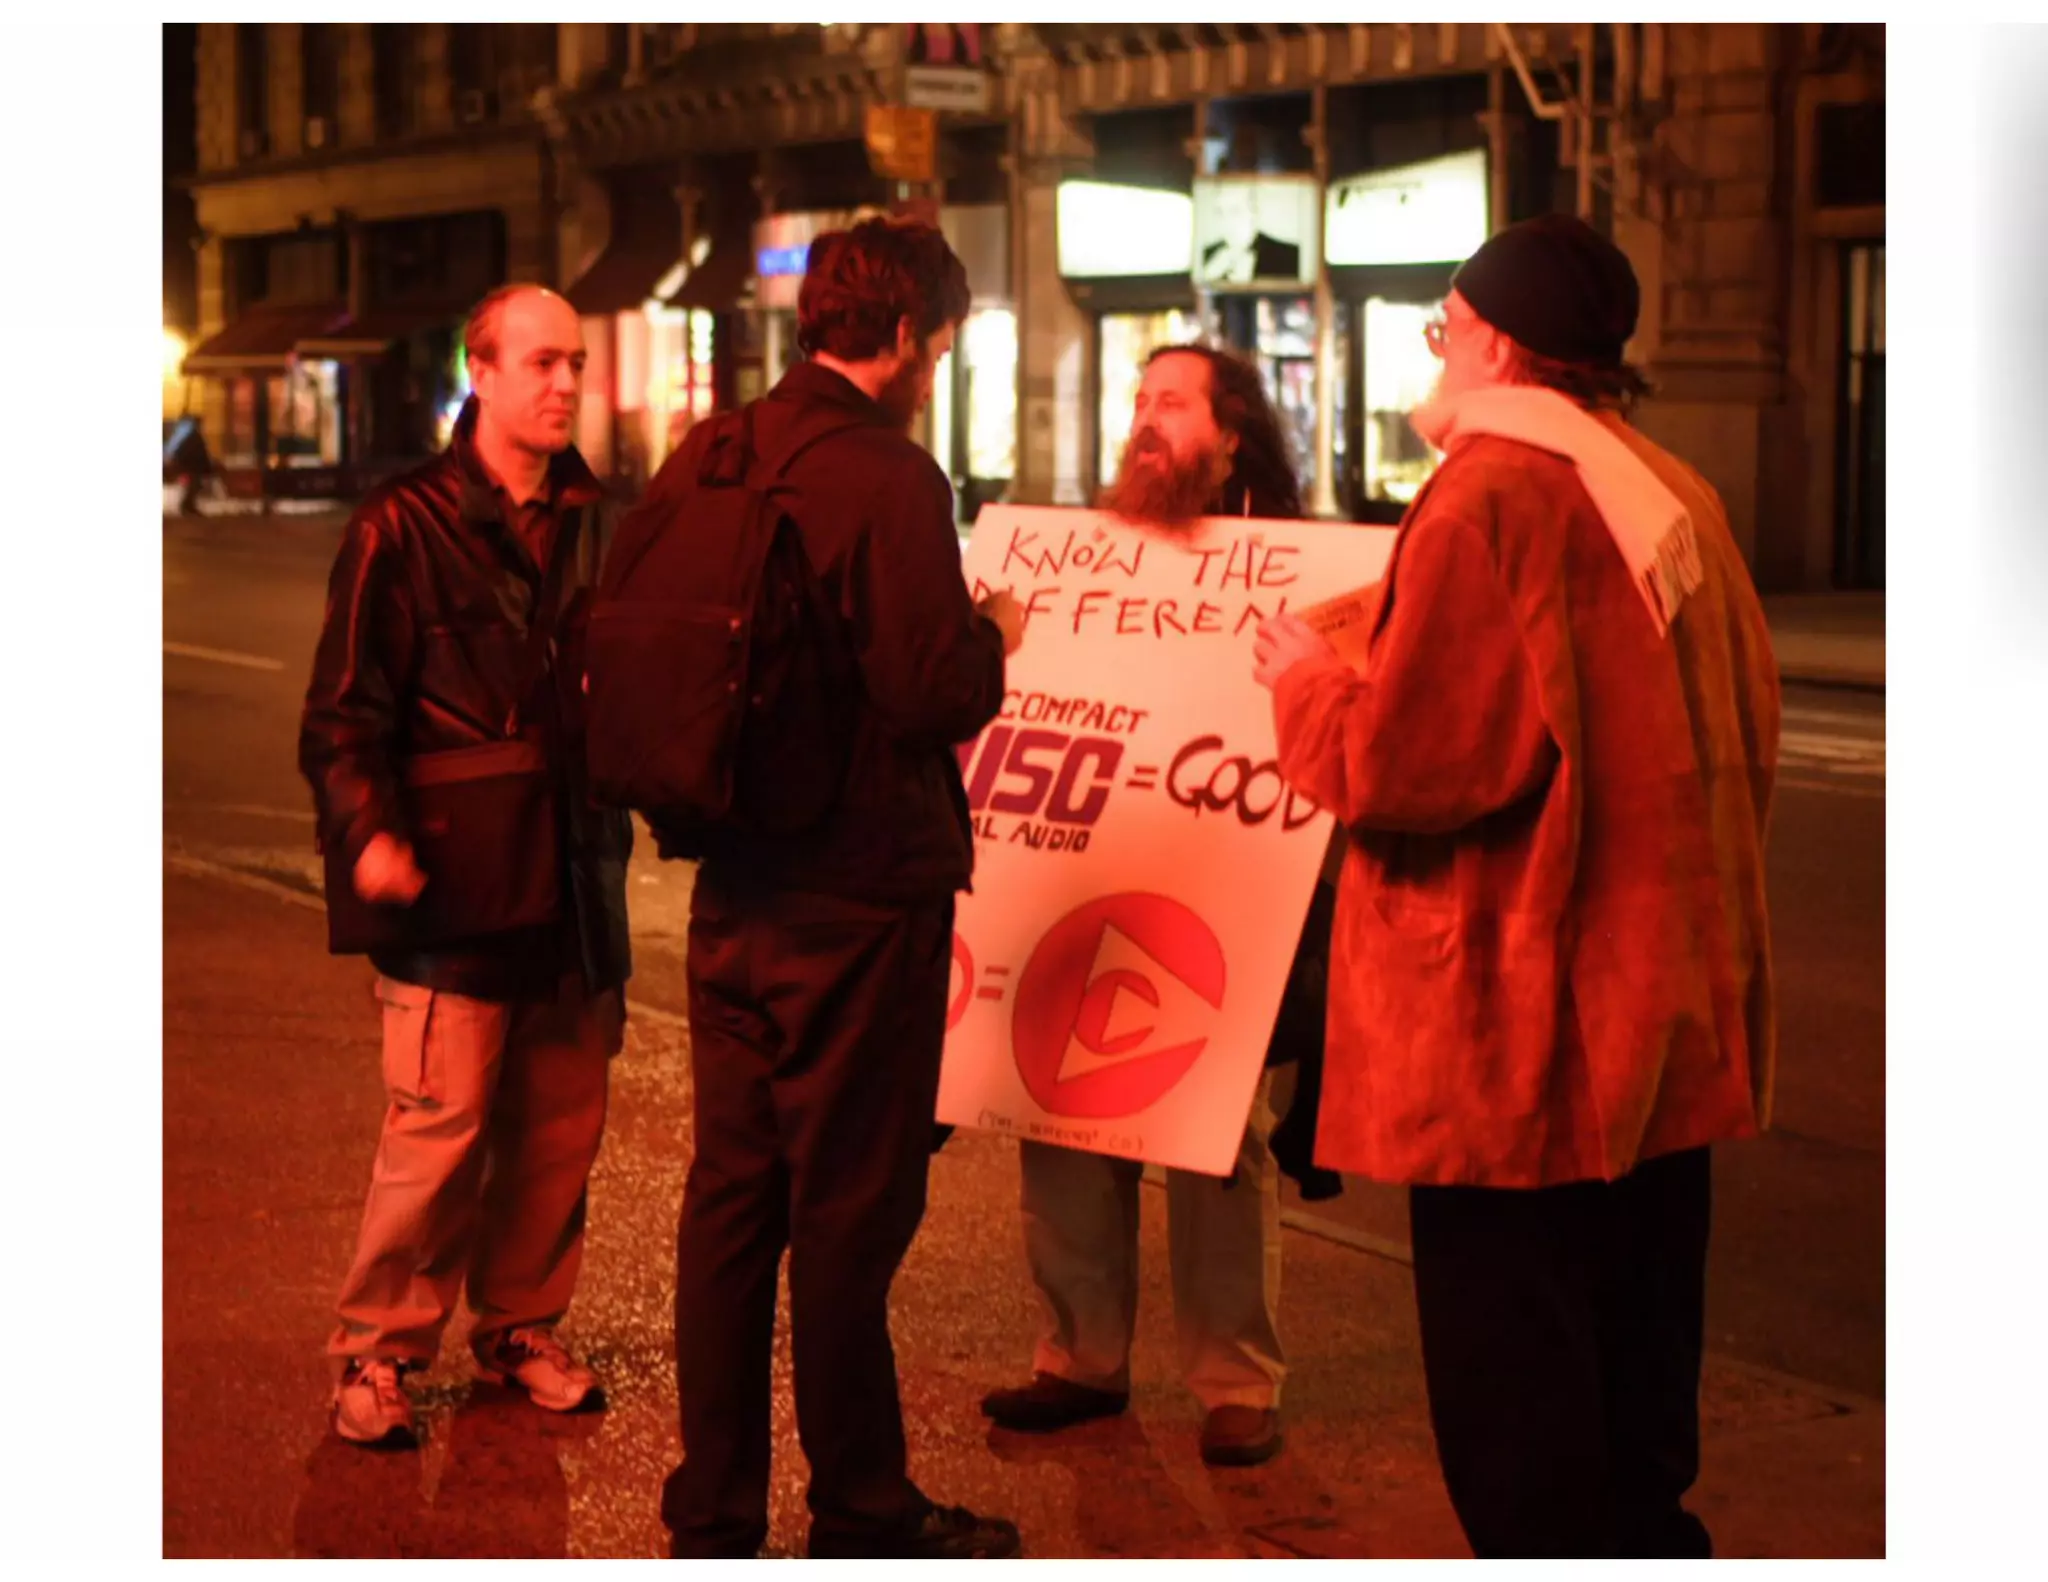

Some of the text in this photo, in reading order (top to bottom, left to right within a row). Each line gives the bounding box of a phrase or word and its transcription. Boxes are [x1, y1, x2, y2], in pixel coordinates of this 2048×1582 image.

[1001, 527, 1300, 591] KNOW THE
[1000, 689, 1150, 735] COMPACT
[957, 725, 1126, 828] ISC
[1165, 734, 1322, 832] GOOD
[1008, 821, 1092, 853] AUDIO
